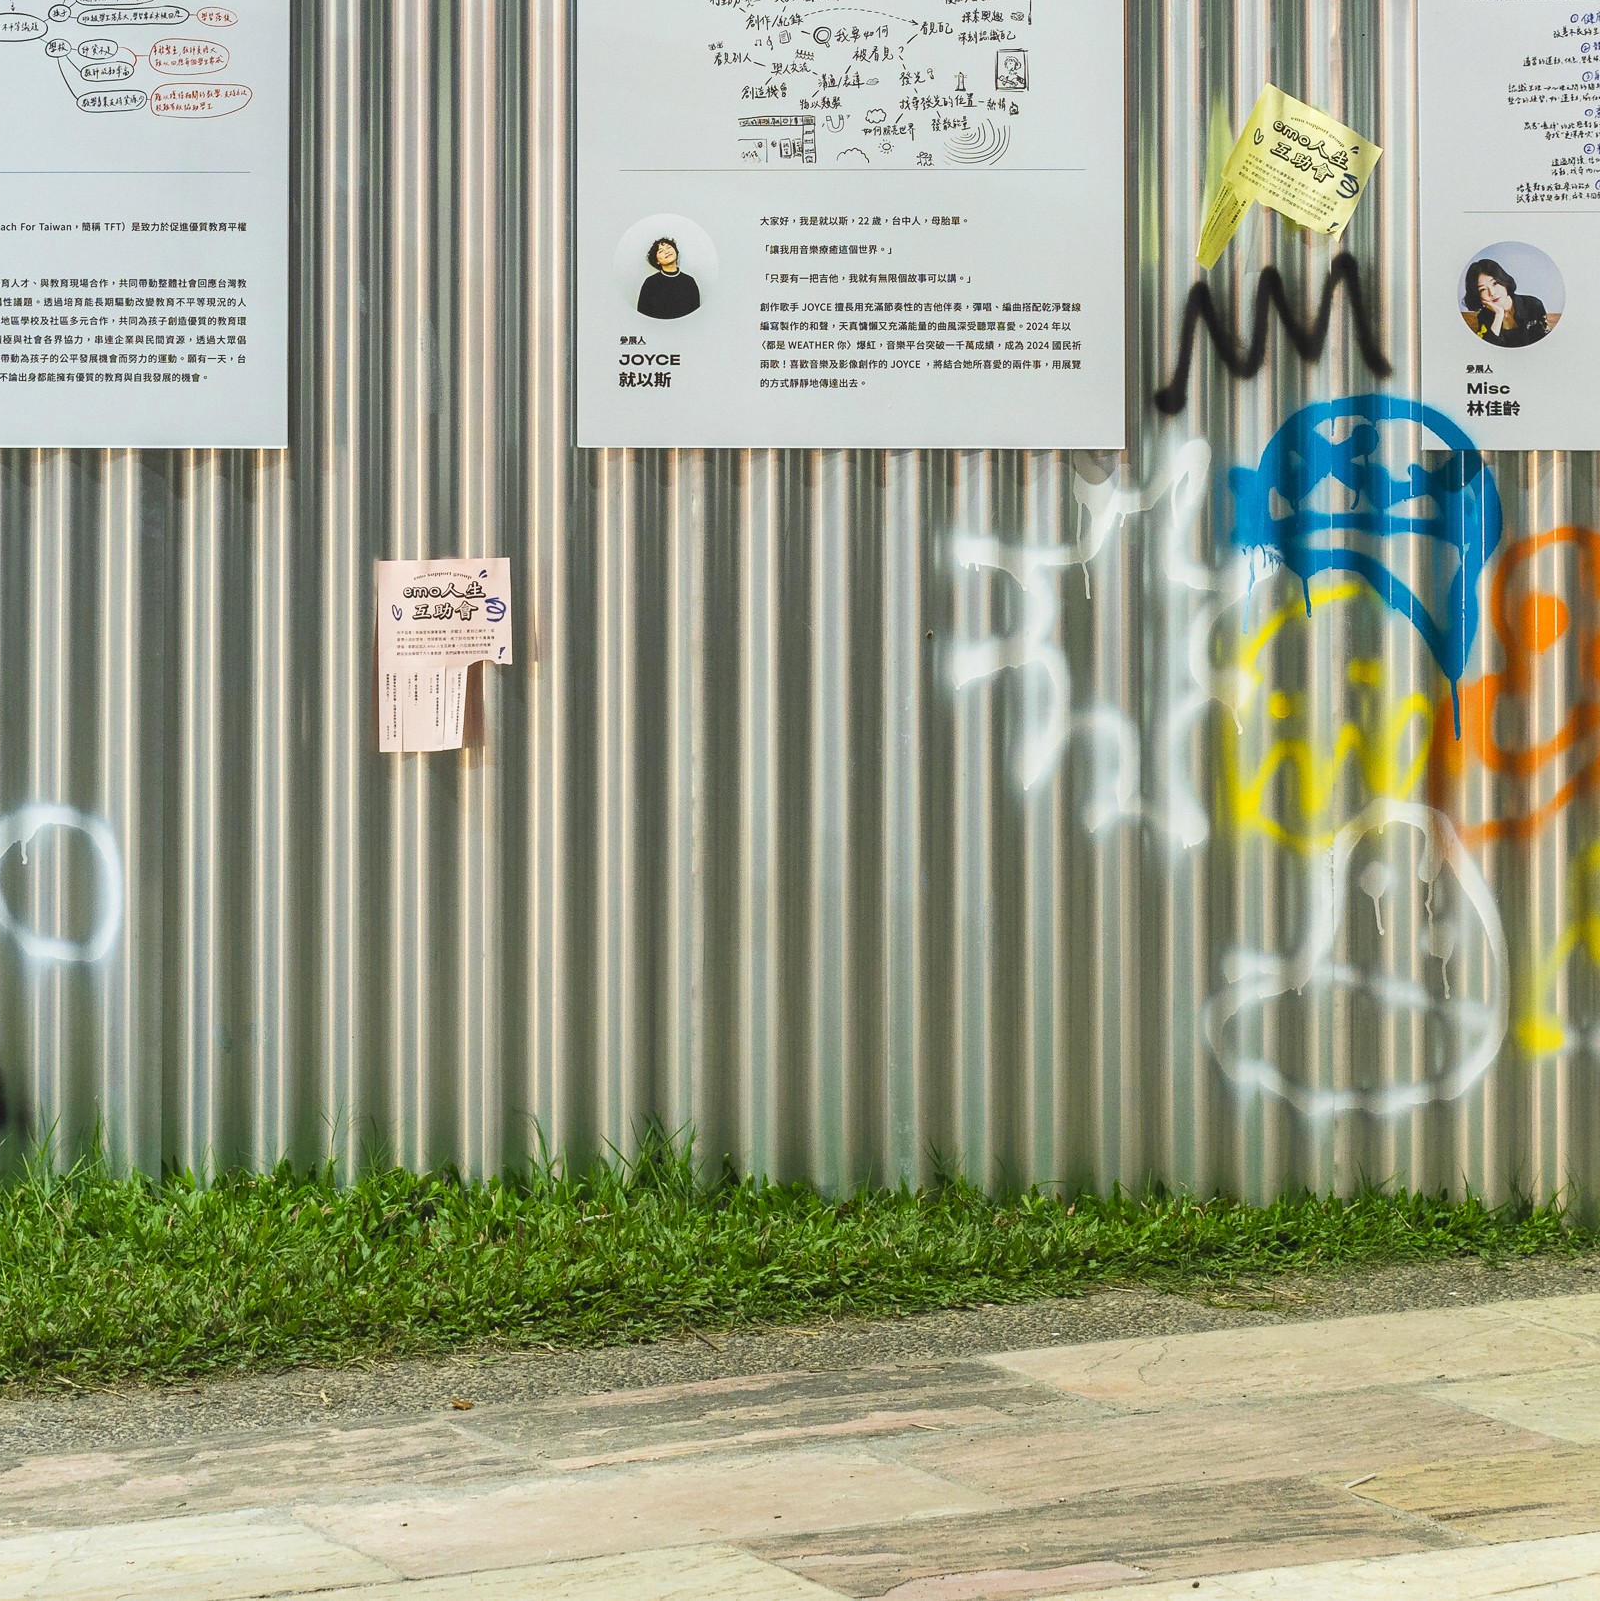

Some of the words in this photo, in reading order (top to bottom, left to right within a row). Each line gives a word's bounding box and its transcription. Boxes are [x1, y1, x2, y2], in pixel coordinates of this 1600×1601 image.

[920, 21, 953, 35] 看見自己
[714, 52, 752, 65] 看見別人
[741, 83, 788, 99] 創造機會
[1273, 119, 1349, 170] emo人生
[1271, 142, 1335, 183] 互助會
[20, 222, 36, 232] For
[871, 215, 968, 226] 歲，台中人，母胎單。
[765, 244, 892, 255] 「讓我用音樂療癒這個世界。」
[765, 273, 971, 284] 「只要有一把吉他，我就有無限個故事可以講。」
[759, 301, 799, 313] 創作歌手
[801, 302, 832, 312] JOYCE
[620, 336, 646, 346] 參展人
[787, 340, 835, 350] WEATHER
[1026, 340, 1050, 350] 2024
[1051, 340, 1082, 351] 國民祈
[618, 353, 681, 366] JOYCE
[1466, 364, 1493, 373] 參展人
[618, 371, 672, 388] 就以斯
[1466, 381, 1511, 395] Misc
[1466, 399, 1521, 417] 林佳齡
[403, 581, 486, 599] emo人生
[412, 601, 478, 621] 互助會
